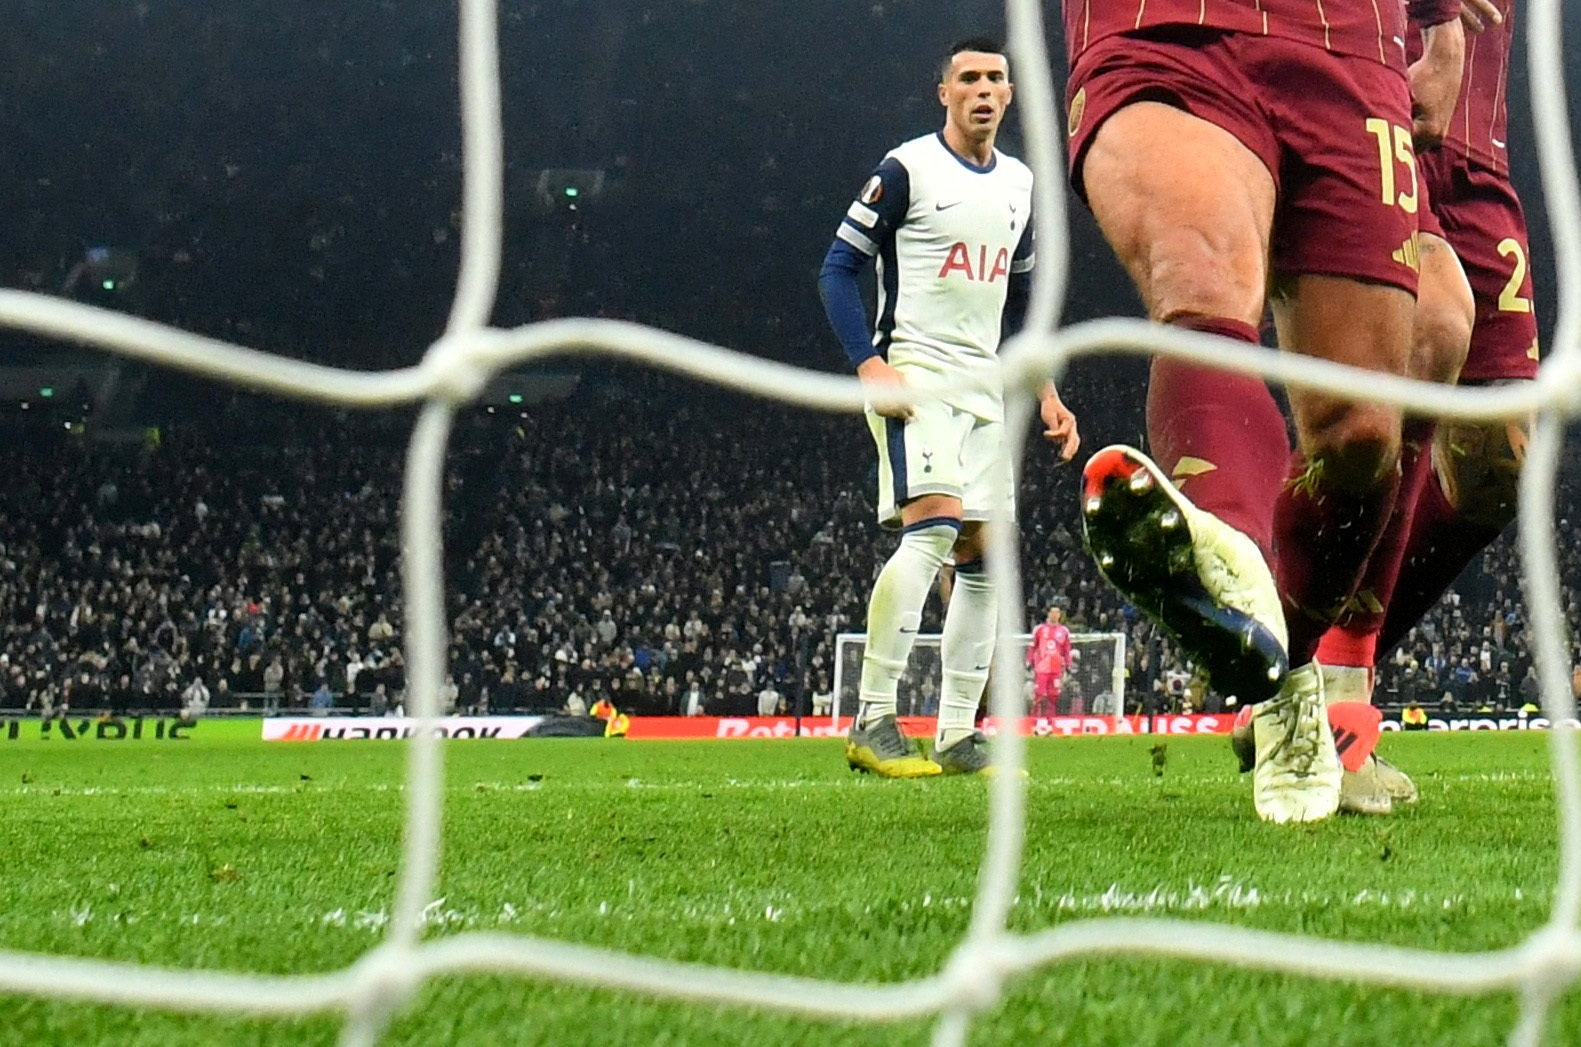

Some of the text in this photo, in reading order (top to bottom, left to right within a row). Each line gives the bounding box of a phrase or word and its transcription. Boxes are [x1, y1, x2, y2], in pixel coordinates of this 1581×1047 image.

[1365, 117, 1418, 214] 15
[938, 241, 1009, 283] AIA
[1035, 717, 1219, 736] TRAUSS
